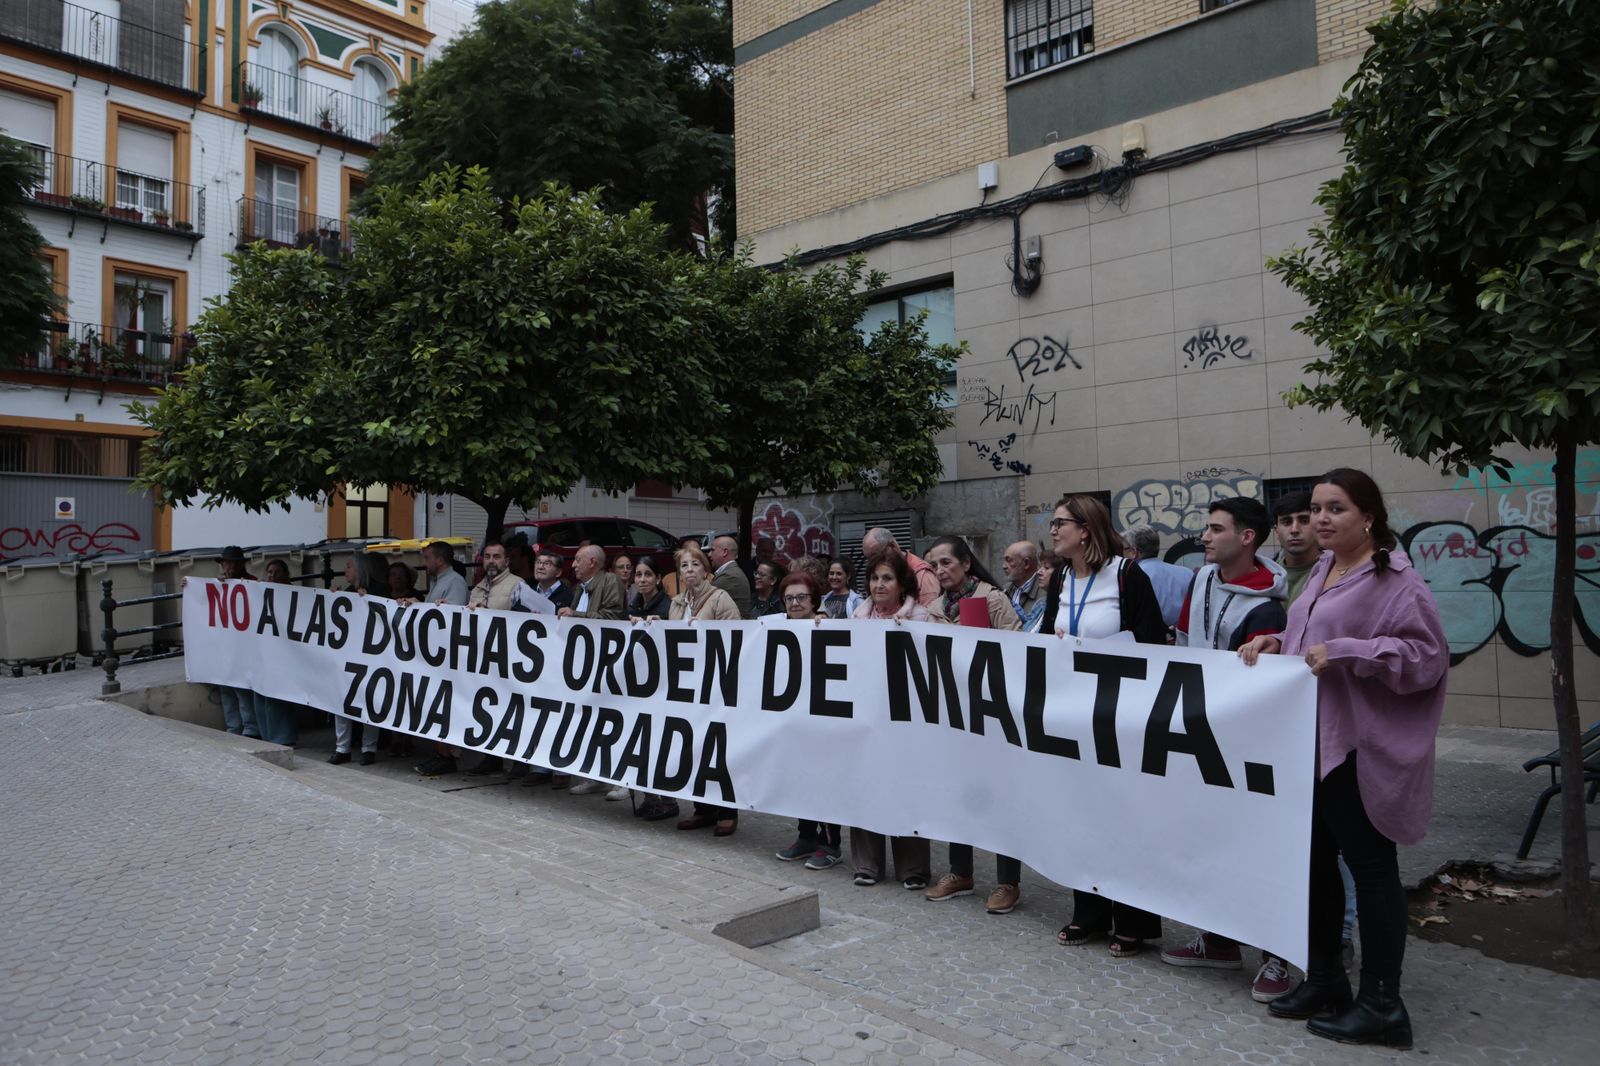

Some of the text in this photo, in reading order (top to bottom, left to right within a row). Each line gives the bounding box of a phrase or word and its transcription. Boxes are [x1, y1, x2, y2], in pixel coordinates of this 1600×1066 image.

[206, 582, 1276, 797] NO A LAS DUCHAS ORDEN DE MALTA.
[344, 661, 737, 803] ZONA SATURADA
